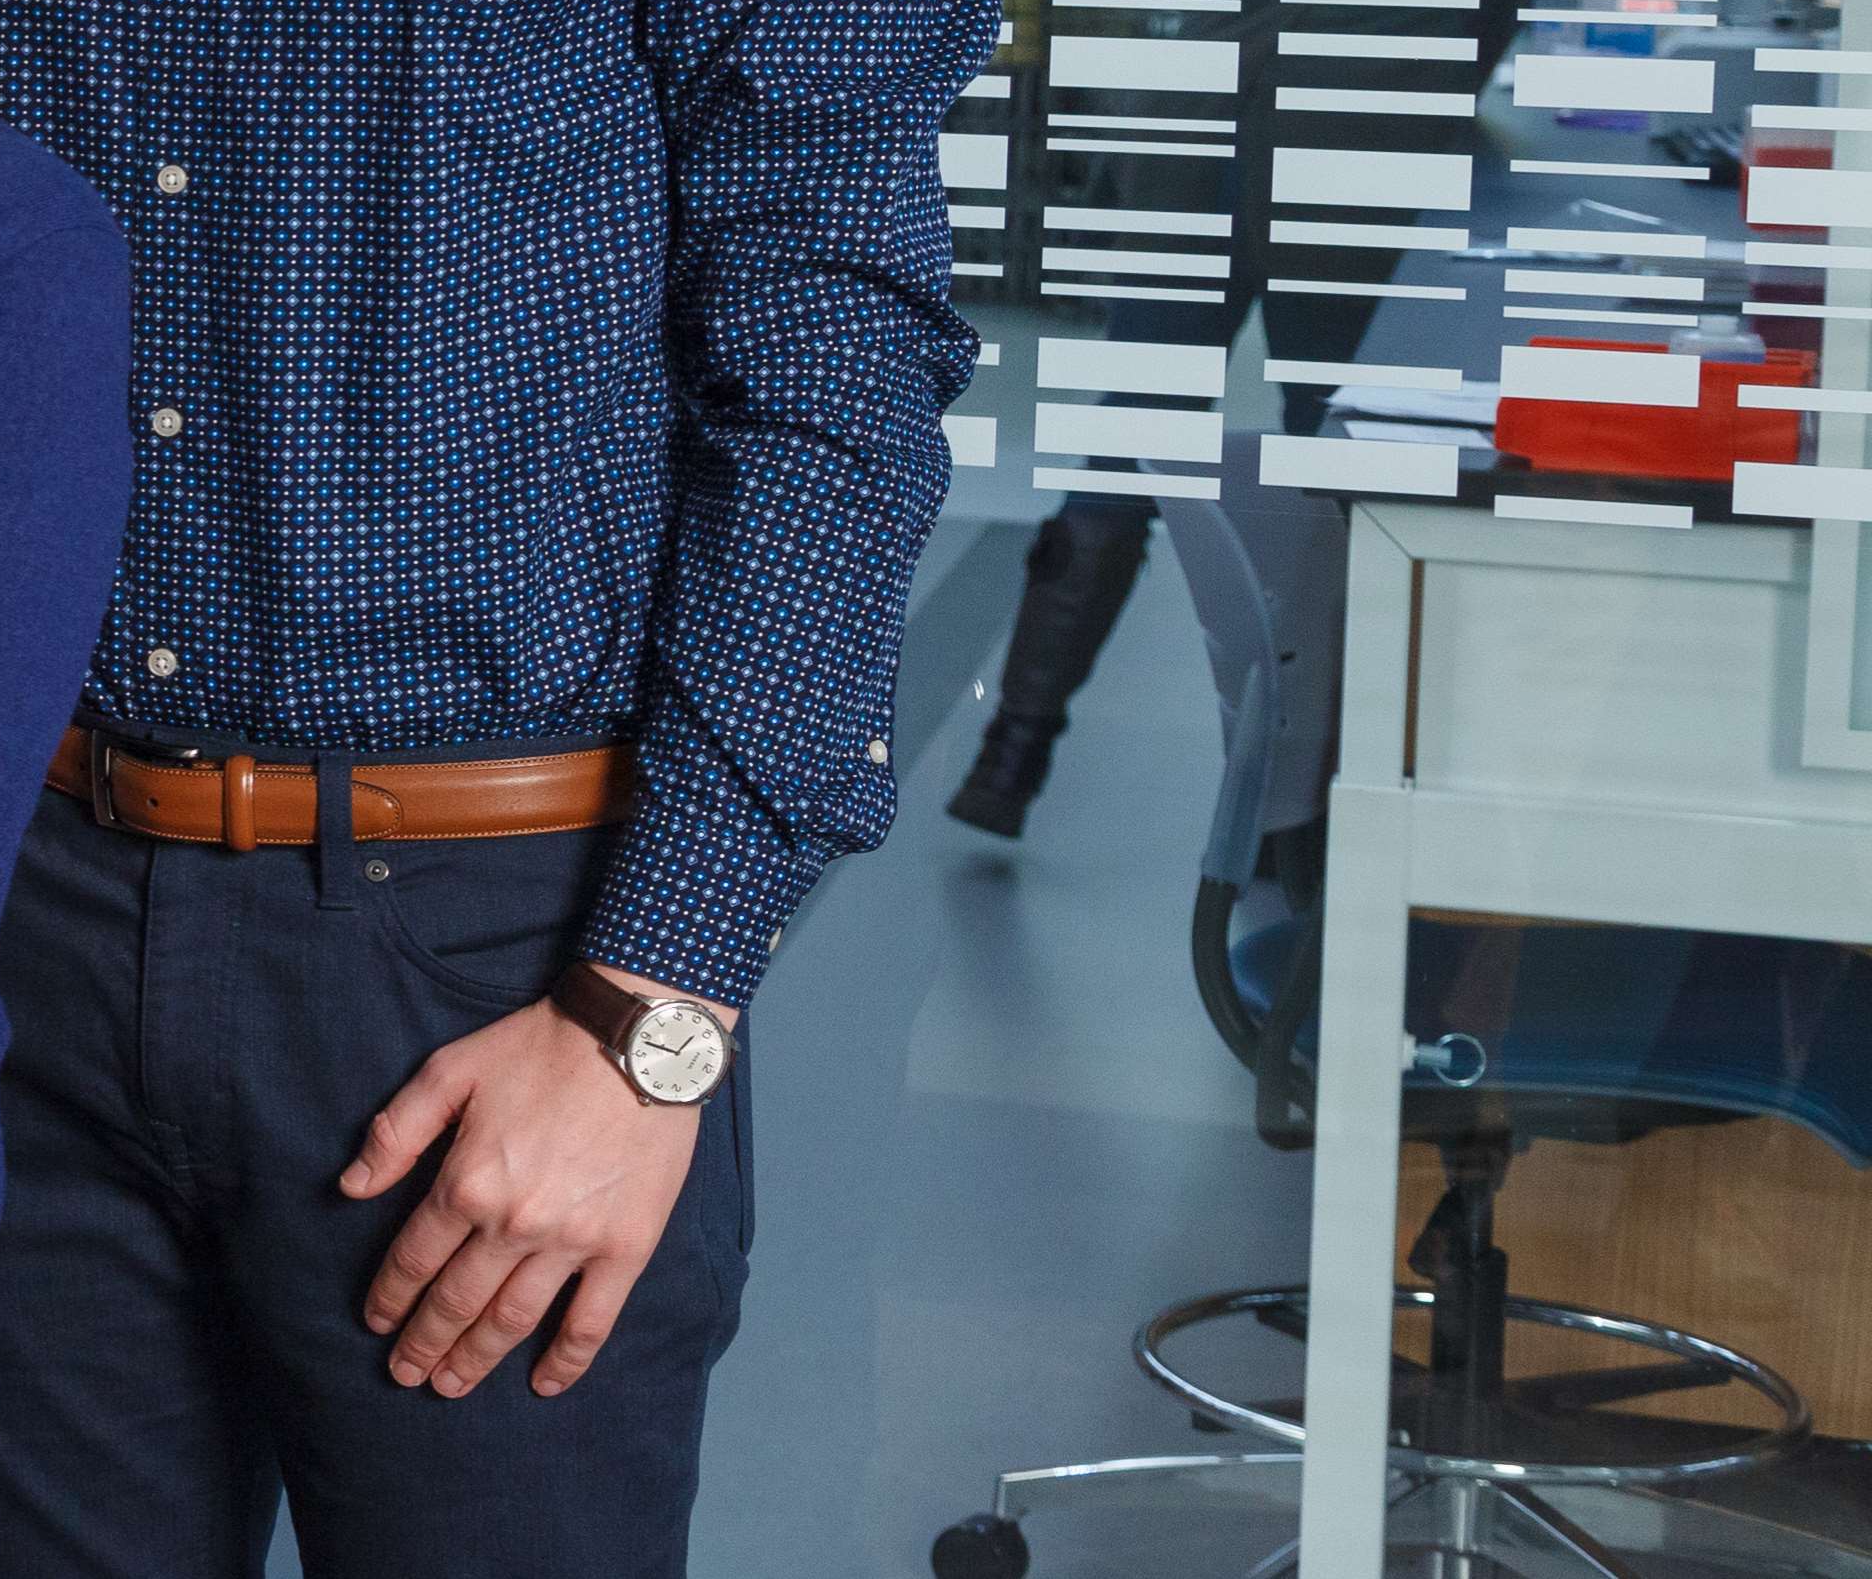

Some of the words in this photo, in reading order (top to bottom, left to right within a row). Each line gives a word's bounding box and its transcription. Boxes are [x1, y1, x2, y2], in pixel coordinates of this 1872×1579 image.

[673, 1011, 683, 1021] 8
[691, 1014, 702, 1024] 9
[655, 1017, 666, 1027] 7
[640, 1031, 652, 1040] 6
[702, 1028, 714, 1039] 10
[635, 1049, 647, 1058] 5
[707, 1046, 718, 1055] 11
[640, 1068, 650, 1076] 4
[702, 1063, 713, 1074] 12
[652, 1080, 663, 1090] 3
[671, 1083, 682, 1092] 2
